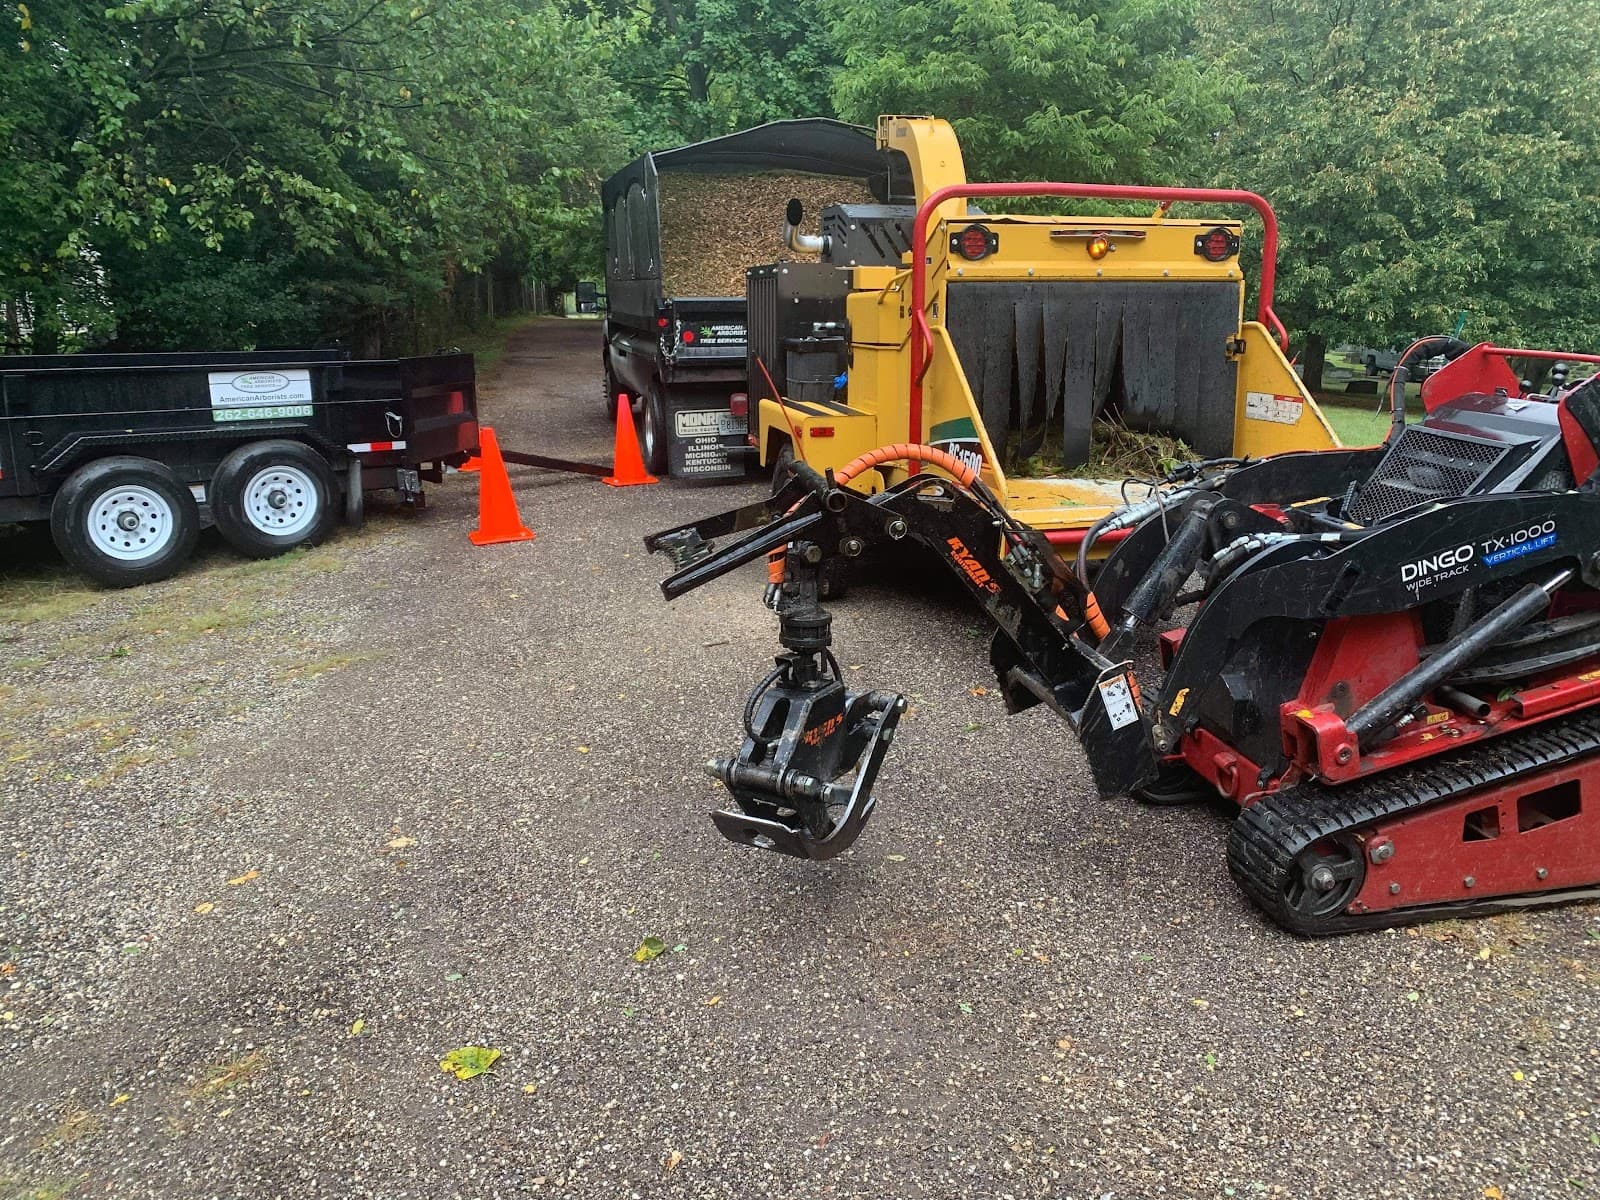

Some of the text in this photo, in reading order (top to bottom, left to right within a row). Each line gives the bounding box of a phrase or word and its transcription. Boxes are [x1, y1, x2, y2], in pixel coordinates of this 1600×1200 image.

[219, 393, 305, 403] AmericanArborists.com
[215, 406, 310, 420] 262-646-9006
[678, 412, 720, 427] MONR
[695, 436, 717, 444] OHIO
[685, 450, 728, 460] MICHIGAN
[685, 458, 728, 466] KENTUCKY
[683, 464, 731, 473] WISCONSIN
[1486, 535, 1555, 564] VERTICAL LIFT
[1401, 544, 1474, 582] DINGO
[1406, 564, 1470, 592] WIDE TRACK
